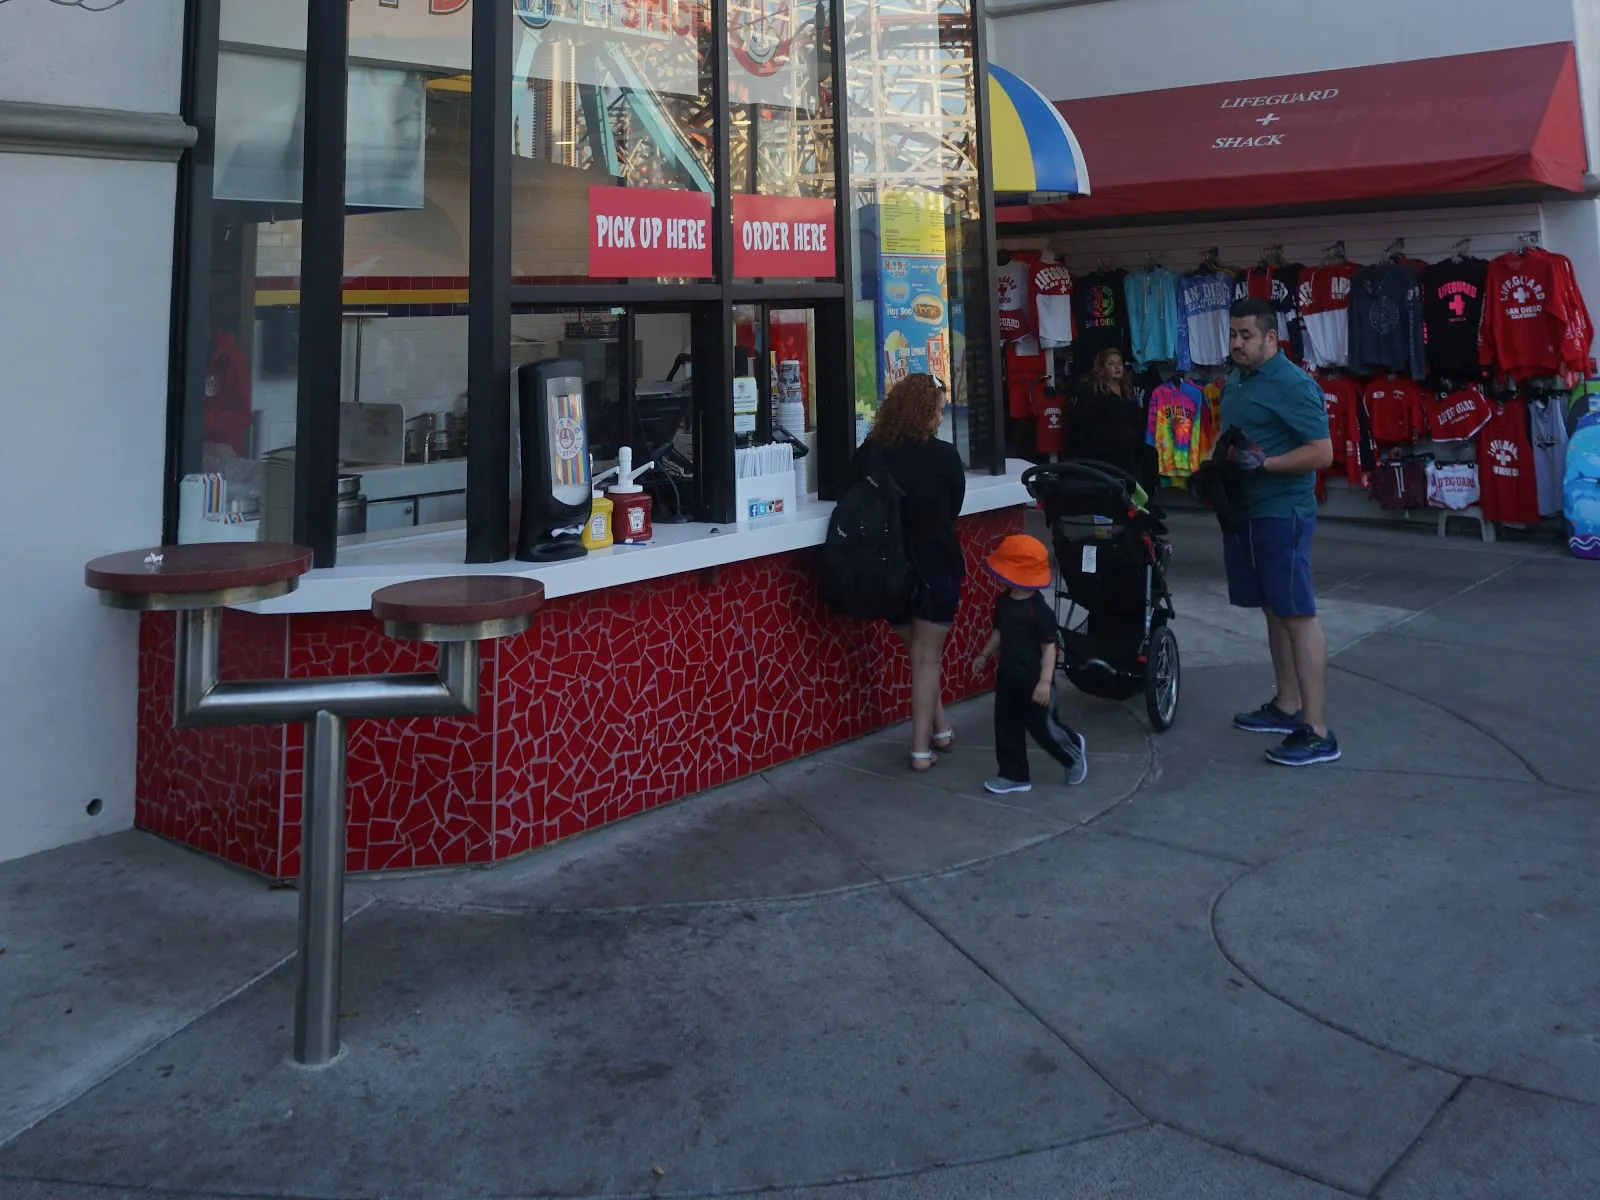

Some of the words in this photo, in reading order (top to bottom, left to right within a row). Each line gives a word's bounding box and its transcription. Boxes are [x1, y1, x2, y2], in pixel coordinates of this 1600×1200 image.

[1220, 88, 1339, 108] LIFEGUARD
[1211, 134, 1286, 148] SHACK
[597, 215, 635, 248] PICK
[640, 217, 662, 248] UP
[667, 219, 706, 250] HERE
[742, 222, 789, 251] ORDER
[793, 223, 827, 252] HERE
[1437, 280, 1478, 300] LIFEGUARD
[1500, 275, 1546, 302] LIFEGUARD
[1505, 308, 1520, 316] SAN
[1520, 305, 1543, 315] DIEGO
[1437, 400, 1476, 425] LIFEGUARD
